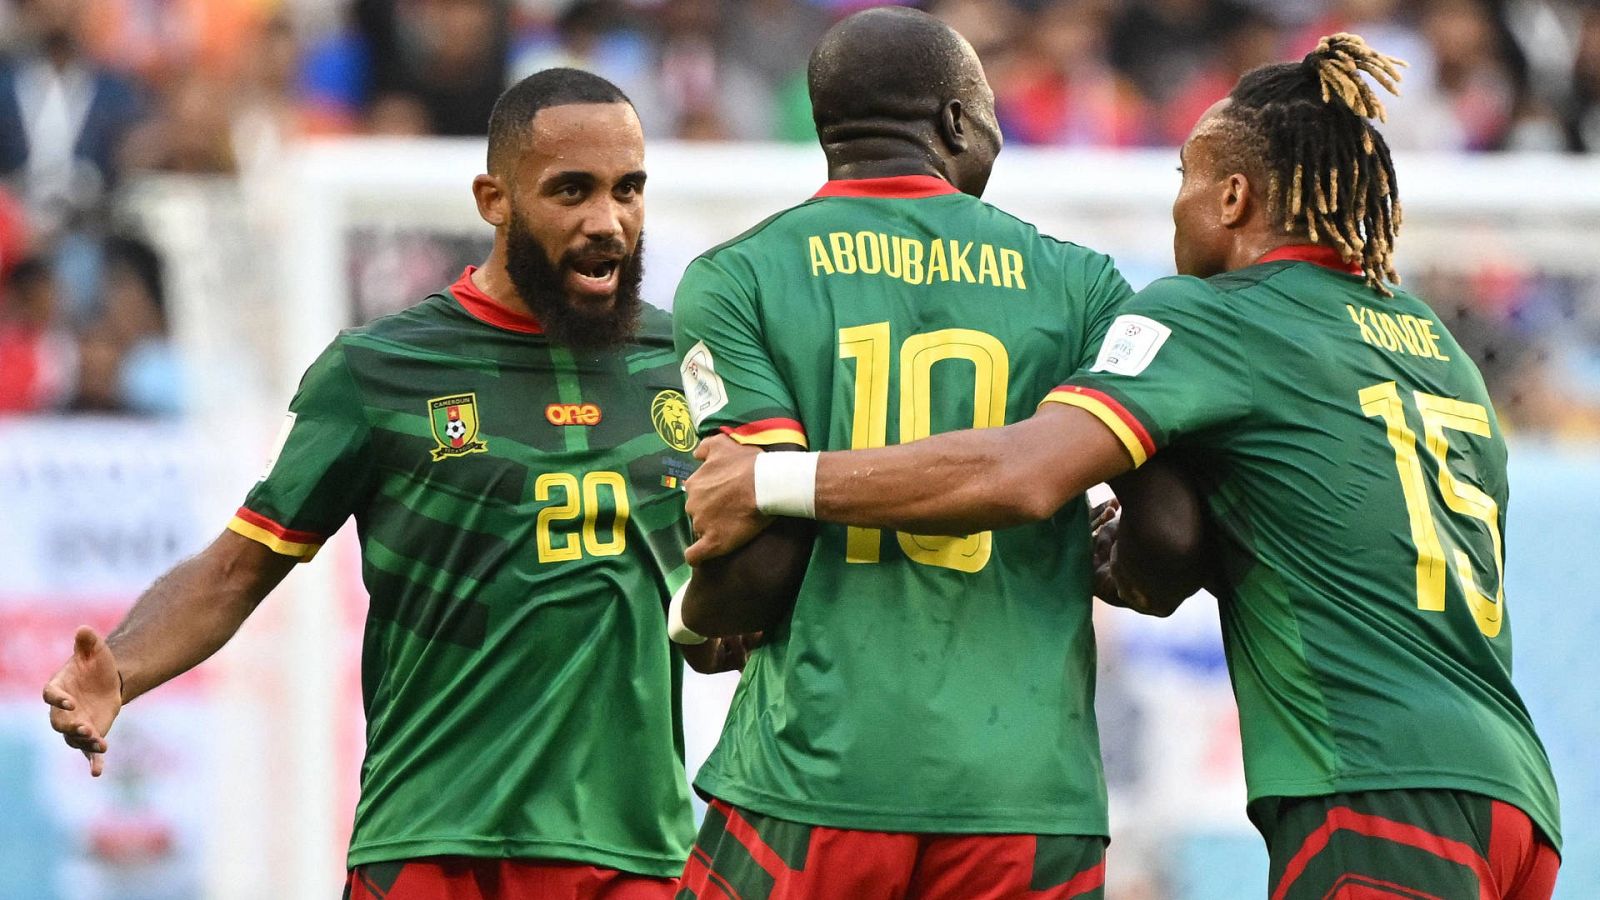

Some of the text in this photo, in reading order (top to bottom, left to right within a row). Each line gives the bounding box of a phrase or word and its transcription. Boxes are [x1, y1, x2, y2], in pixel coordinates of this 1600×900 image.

[808, 231, 1026, 290] ABOUBAKAR
[1346, 304, 1450, 361] KUNDE
[433, 397, 471, 408] CAMEROUN
[547, 404, 601, 425] one
[839, 321, 1009, 573] 10
[535, 471, 629, 563] 20
[1358, 381, 1505, 638] 15
